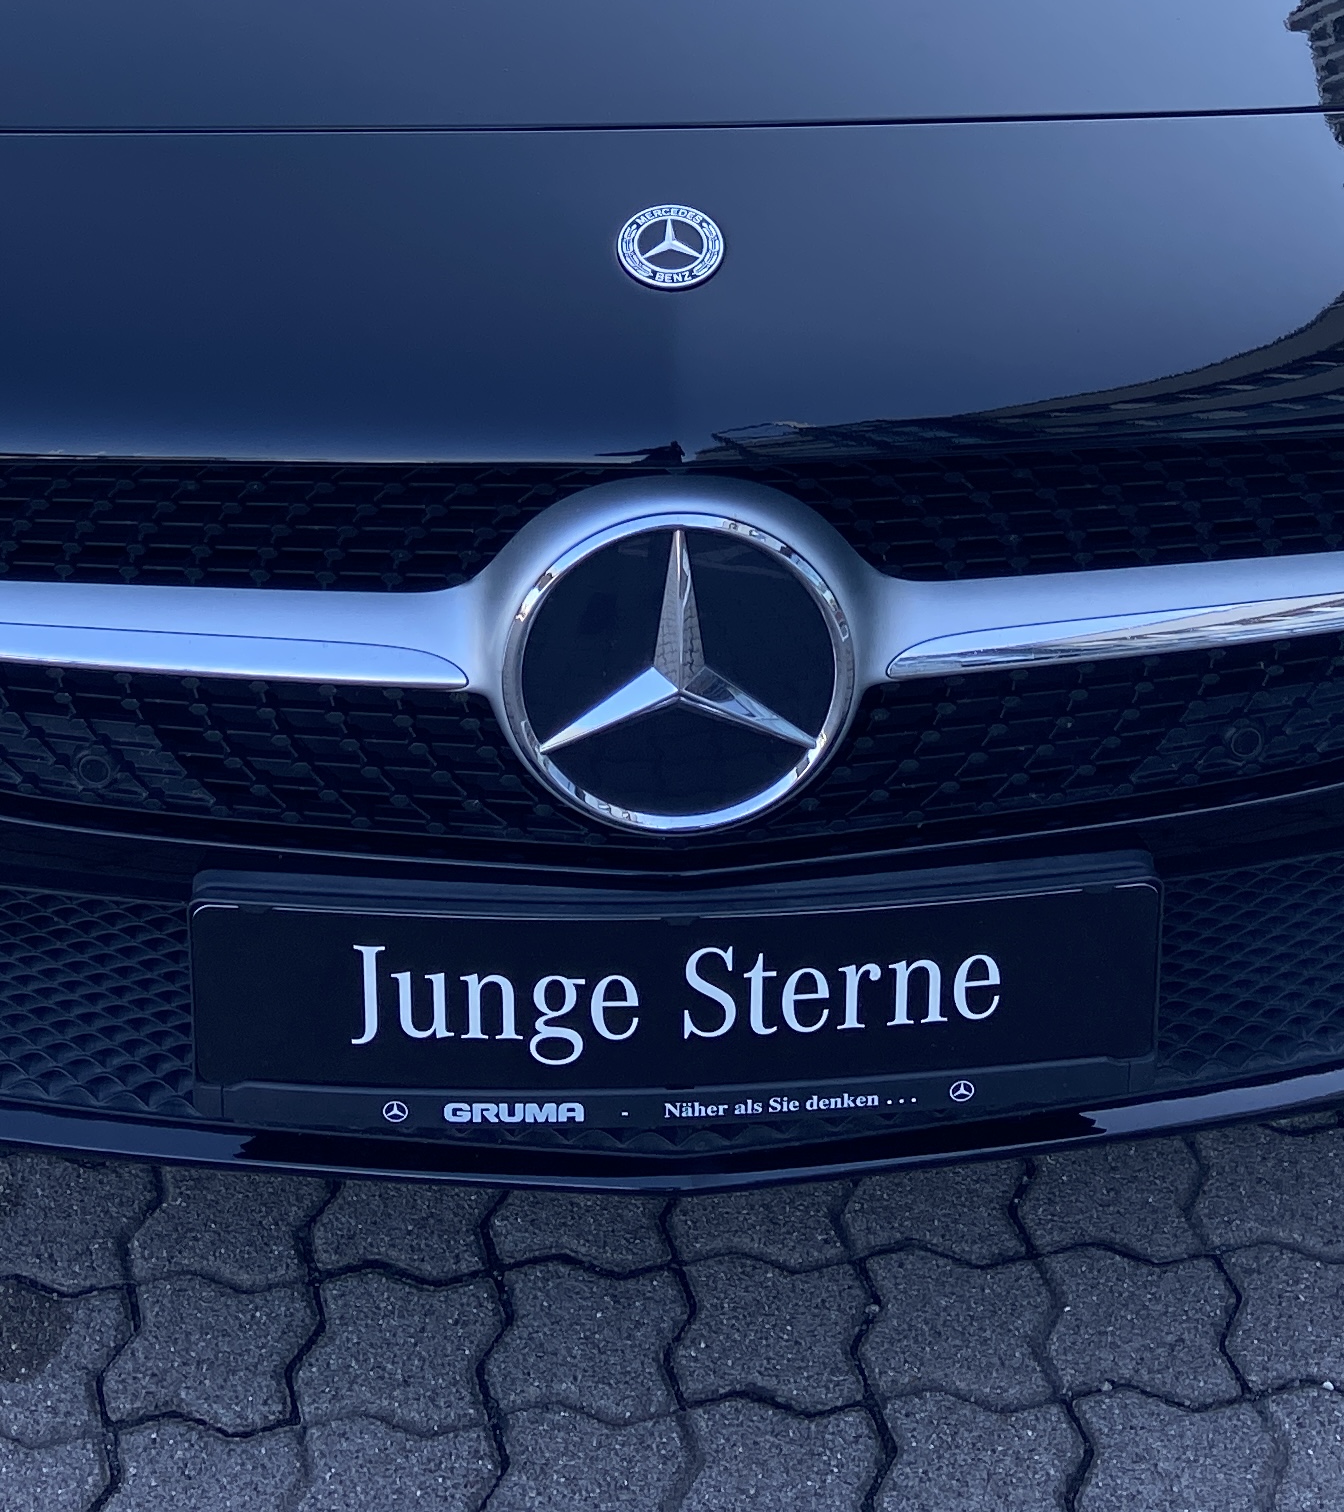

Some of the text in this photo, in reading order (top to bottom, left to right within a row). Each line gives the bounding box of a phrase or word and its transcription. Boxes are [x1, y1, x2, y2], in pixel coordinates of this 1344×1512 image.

[635, 208, 703, 226] MERCEDES
[655, 271, 692, 283] BENZ
[351, 944, 1001, 1065] Junge Sterne
[443, 1102, 585, 1123] GRUMA
[664, 1102, 728, 1118] Näher
[734, 1099, 763, 1115] als
[768, 1096, 800, 1113] Sie
[805, 1093, 879, 1111] denken
